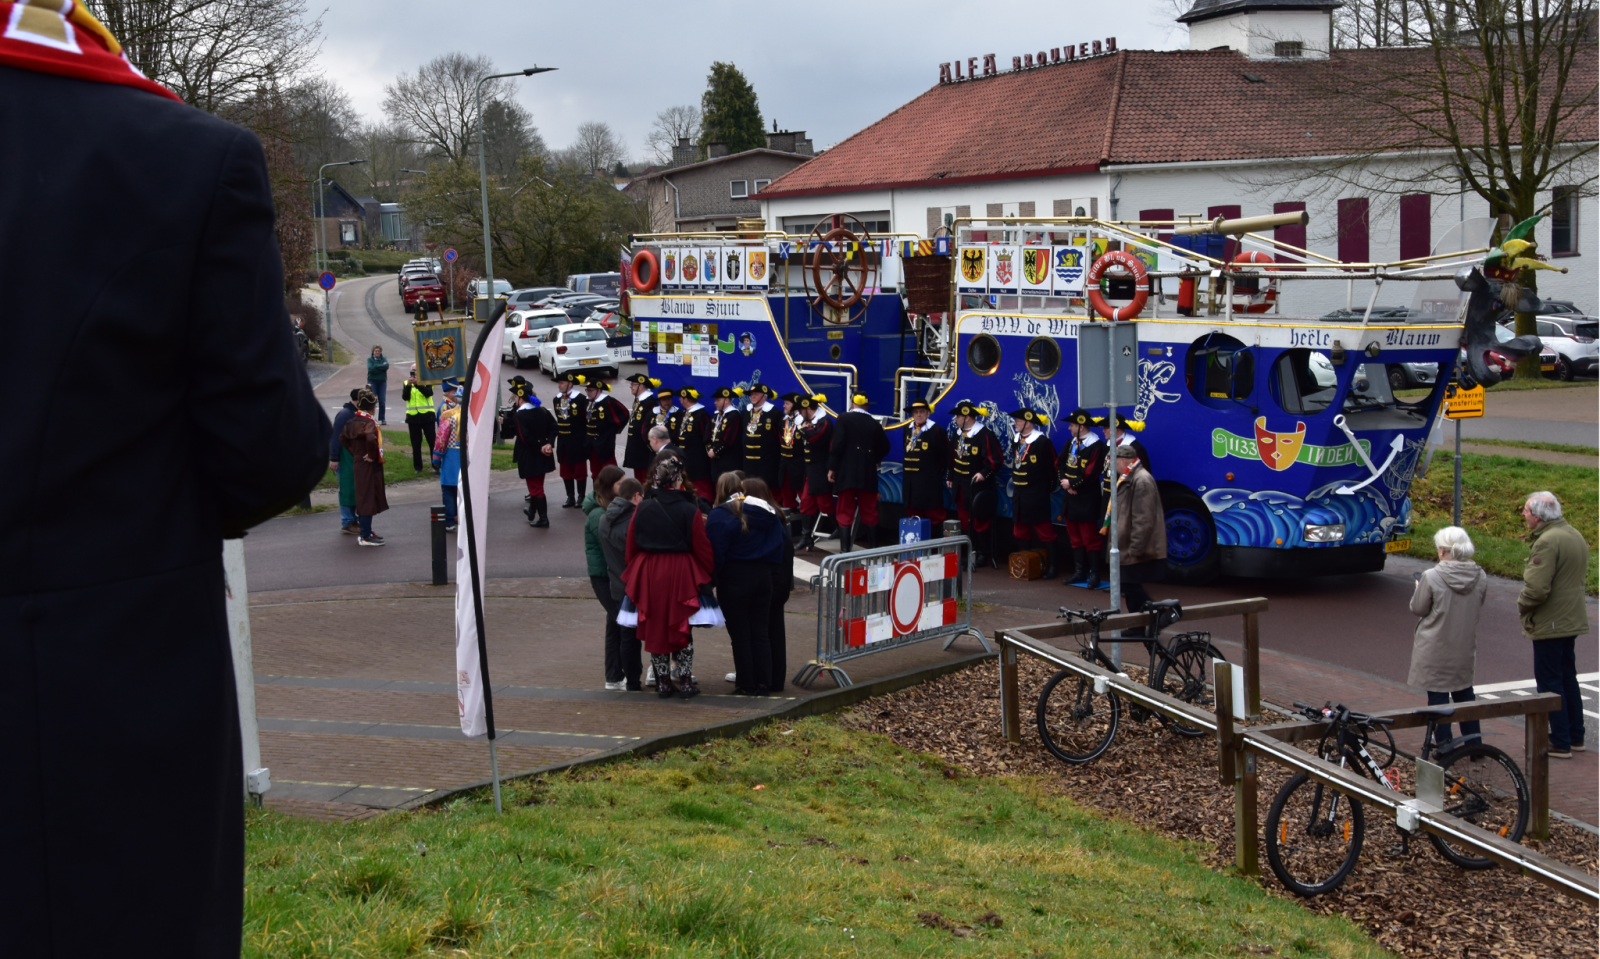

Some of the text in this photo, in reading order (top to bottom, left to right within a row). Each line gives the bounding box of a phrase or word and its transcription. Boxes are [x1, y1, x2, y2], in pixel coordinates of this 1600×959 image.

[939, 53, 997, 83] ALFA
[661, 298, 741, 318] Blauw Sjuut
[1027, 319, 1041, 335] de
[1047, 318, 1081, 336] Win
[1290, 328, 1441, 347] heële Blauw
[1444, 399, 1483, 407] ansferium
[1452, 391, 1483, 400] arkeren
[1229, 437, 1354, 464] 1133 INDEN
